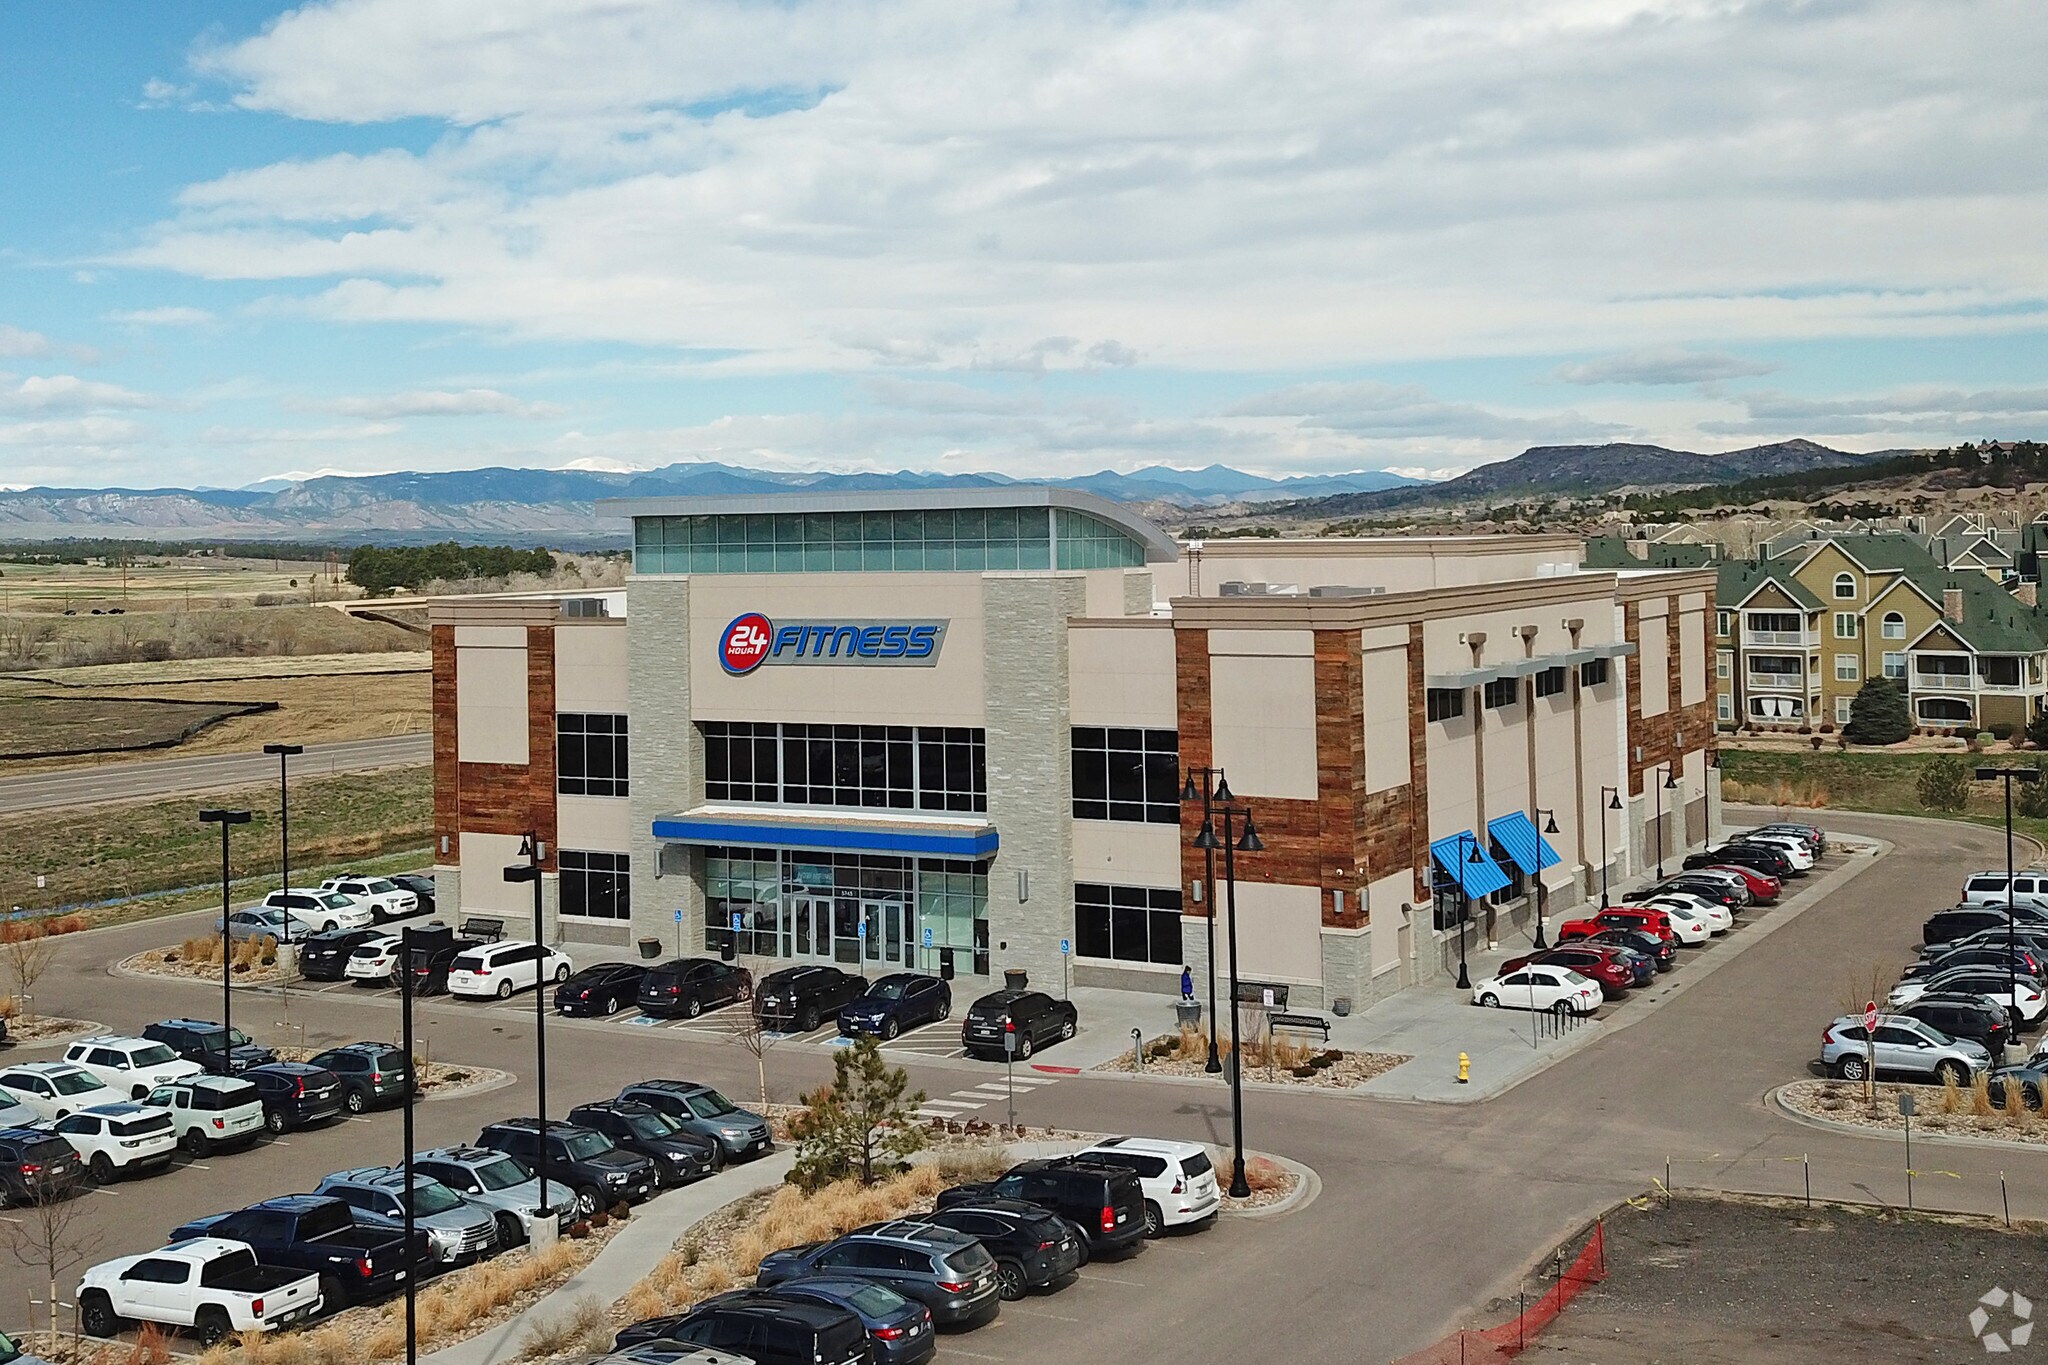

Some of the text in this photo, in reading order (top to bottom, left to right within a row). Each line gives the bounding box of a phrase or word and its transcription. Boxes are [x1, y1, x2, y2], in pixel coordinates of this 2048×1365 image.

[727, 647, 755, 655] HOUR
[730, 626, 767, 655] 24
[773, 625, 937, 657] FITNESS
